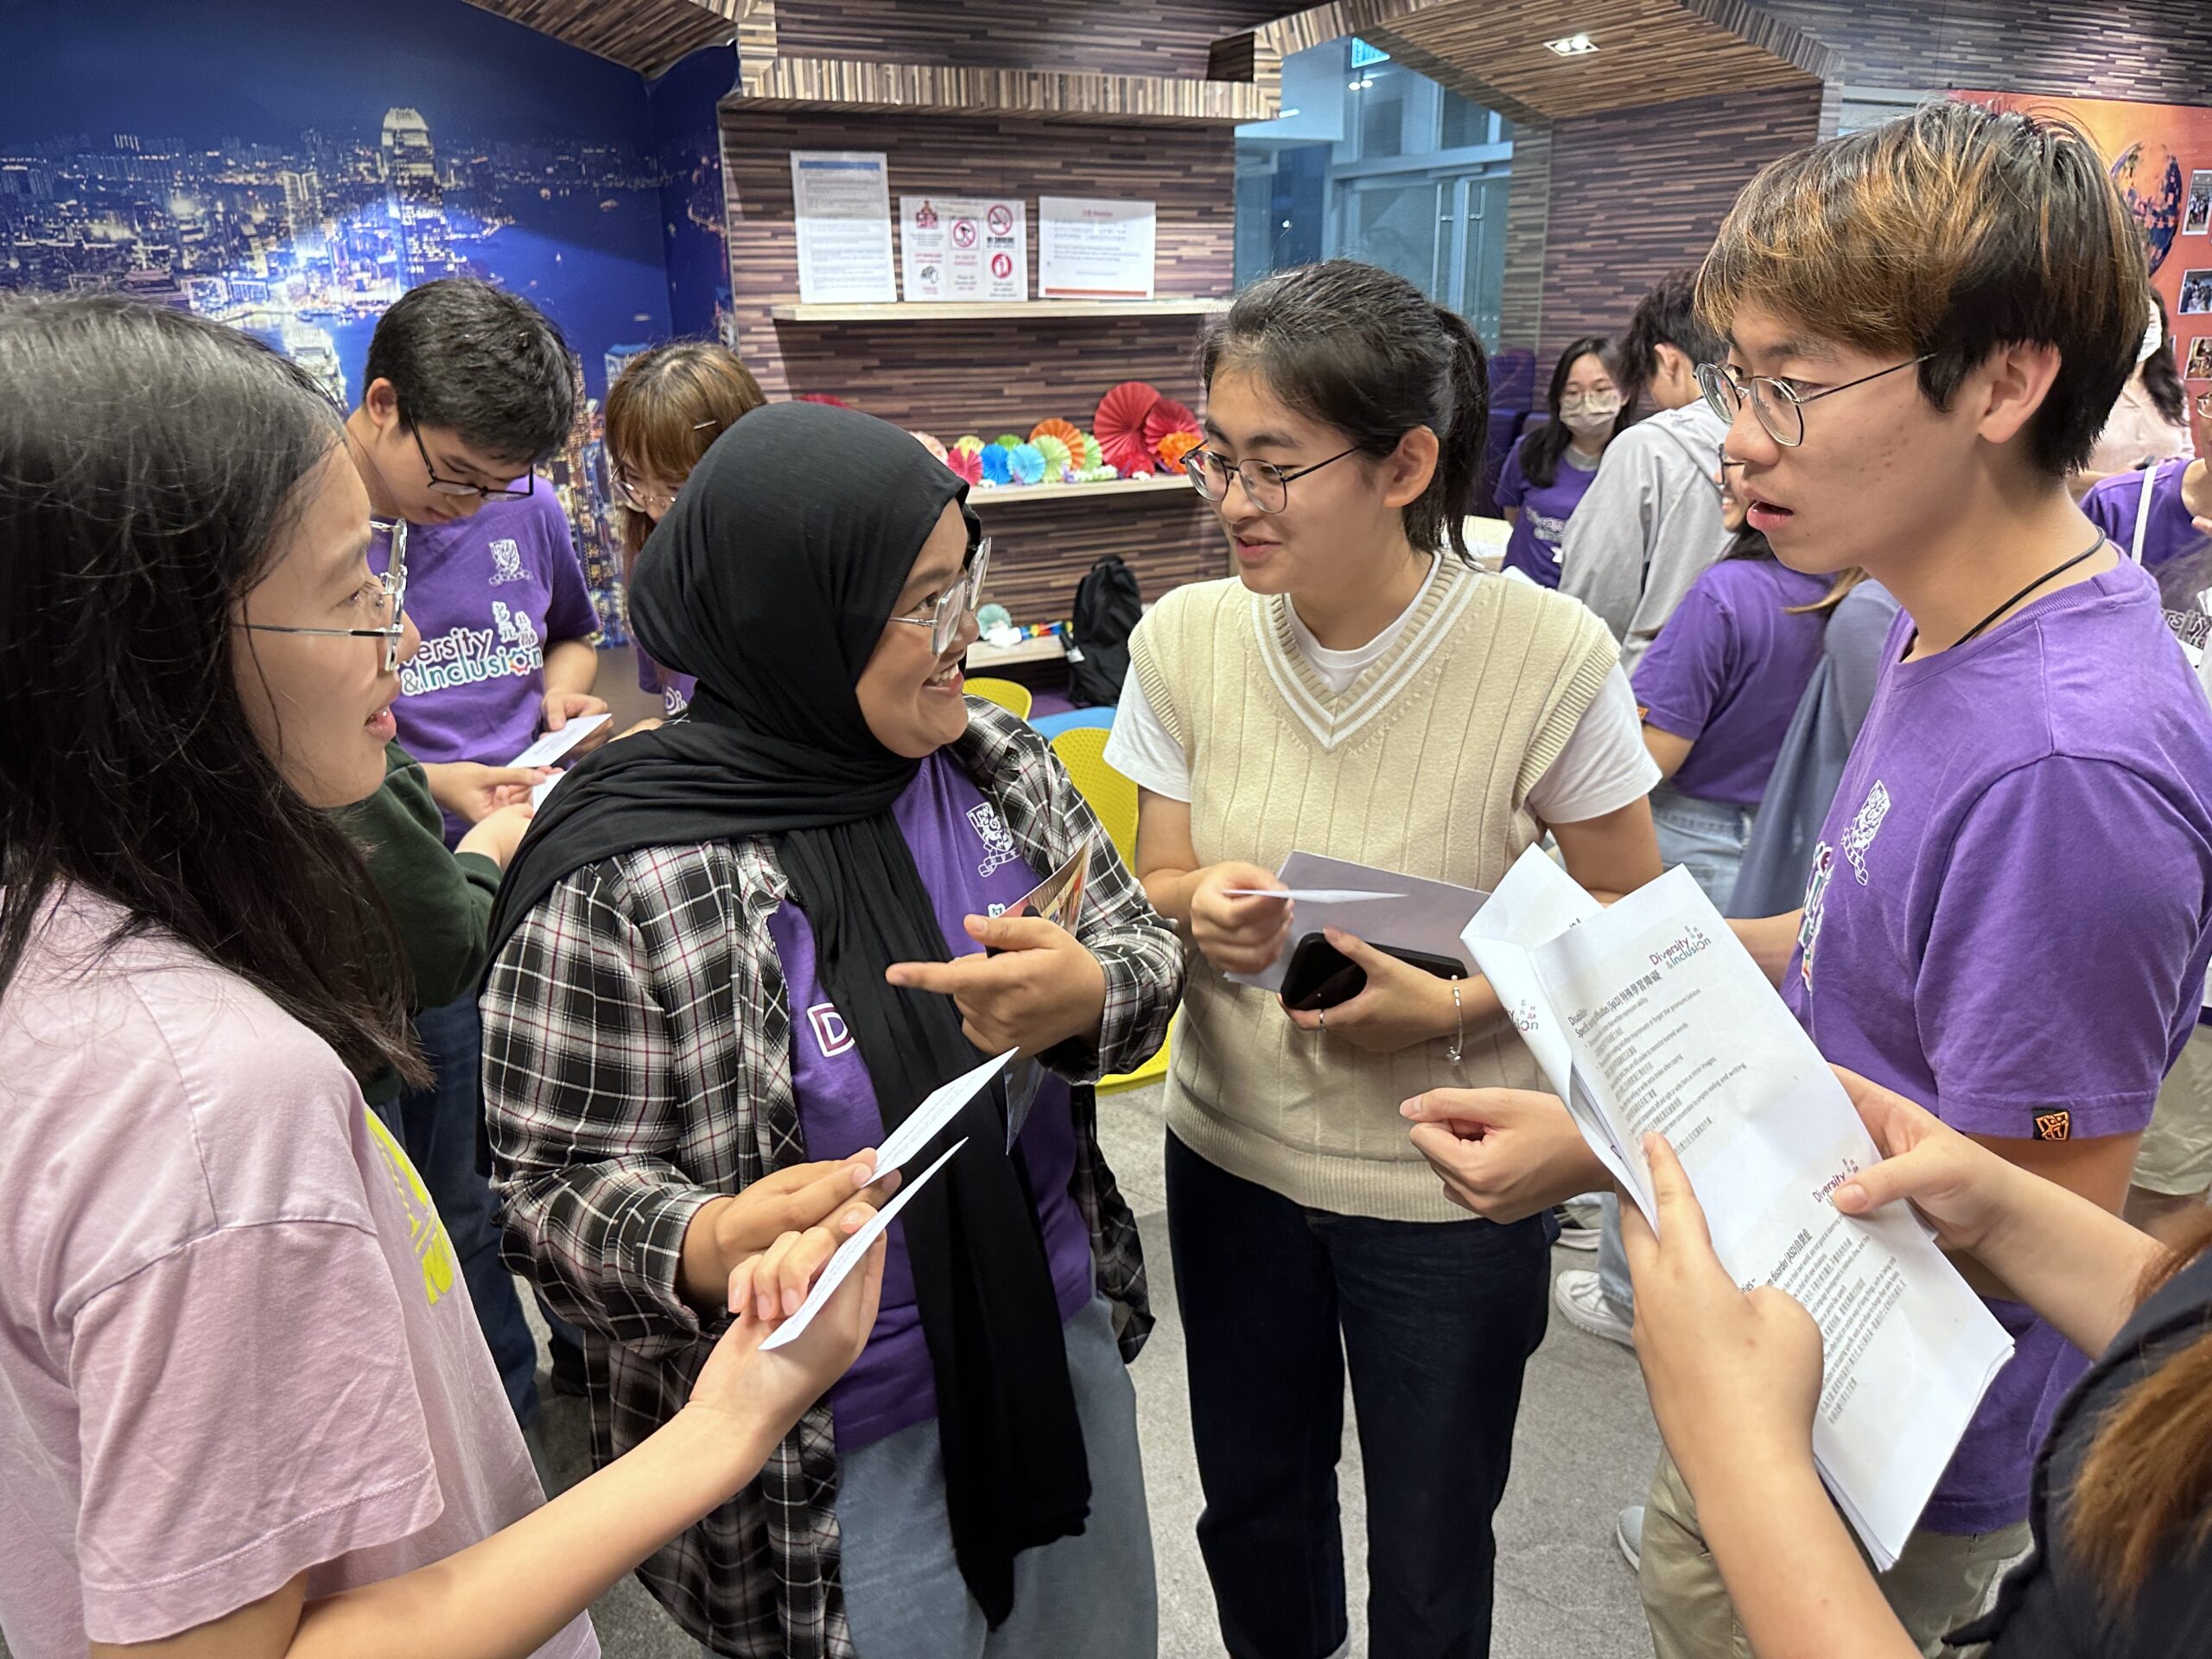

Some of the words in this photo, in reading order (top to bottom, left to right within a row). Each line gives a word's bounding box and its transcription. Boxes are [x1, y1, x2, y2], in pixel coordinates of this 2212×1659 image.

[1649, 938, 1689, 965] Diversity
[1670, 988, 1701, 1012] pronunciation
[1676, 1022, 1688, 1033] words
[1719, 1073, 1729, 1083] and
[1729, 1063, 1746, 1077] writing
[1812, 1172, 1845, 1202] Diversity
[1770, 1260, 1789, 1282] disorder
